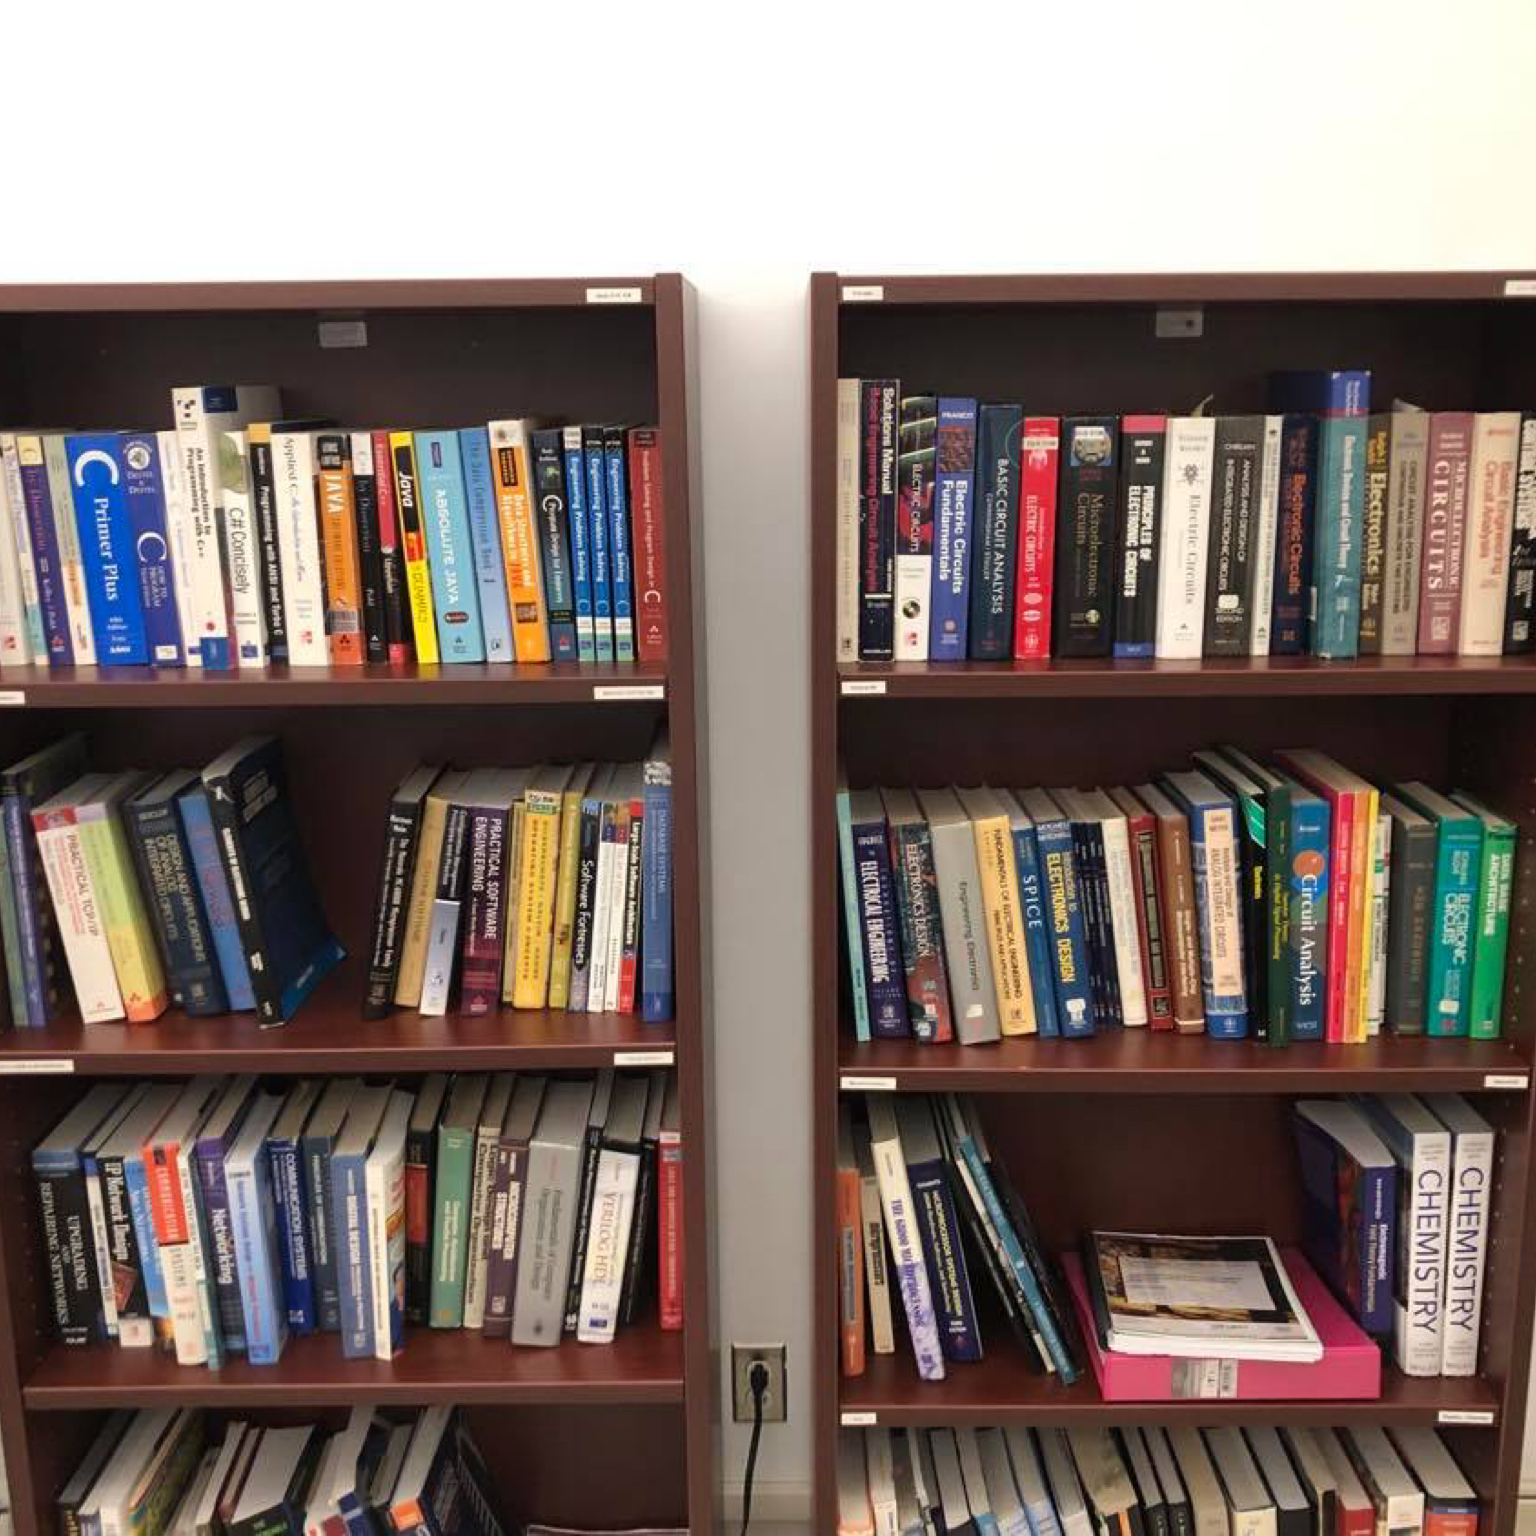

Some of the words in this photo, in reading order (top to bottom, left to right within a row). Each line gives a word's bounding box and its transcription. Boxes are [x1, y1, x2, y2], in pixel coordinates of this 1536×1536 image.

[881, 388, 895, 446] Solutions
[74, 450, 119, 487] C
[187, 447, 200, 514] Programming
[199, 463, 211, 523] Introduction
[325, 474, 345, 514] JAVA
[399, 471, 414, 508] Java
[610, 458, 621, 511] Engineering
[881, 449, 893, 495] Manual
[911, 463, 923, 507] ELECTRIC
[996, 458, 1010, 497] BASIC
[94, 498, 113, 560] Primer
[229, 508, 245, 530] C#
[614, 512, 624, 550] Problem
[909, 511, 921, 552] CIRCUITS
[939, 480, 955, 582] Fundamentals
[954, 480, 969, 534] Electric
[993, 500, 1008, 549] CIRCUIT
[1076, 493, 1090, 545] Circuits
[1126, 485, 1141, 547] ELECTRONIC
[1140, 485, 1156, 545] PRINCIPLES
[1187, 494, 1202, 549] Electric
[1367, 473, 1388, 576] Electronics
[1427, 460, 1451, 589] CIRCUITS
[1449, 461, 1467, 587] MICROELECTRONIC
[137, 531, 167, 562] C
[231, 532, 251, 594] Concisely
[434, 490, 455, 565] ABSOLUTE
[446, 569, 459, 604] JAVA
[615, 551, 625, 582] Solving
[951, 538, 968, 594] Circuits
[1087, 494, 1106, 597] Microelectronic
[1140, 548, 1153, 562] OF
[103, 564, 119, 601] Plus
[991, 552, 1006, 614] ANALYSIS
[1124, 551, 1138, 598] CIRCUITS
[1185, 553, 1198, 605] Circuits
[67, 834, 88, 895] PRACTICAL
[471, 816, 488, 892] ENGINEERING
[487, 818, 502, 877] PRACTICAL
[578, 859, 595, 908] Software
[861, 861, 884, 917] ELECTRICAL
[905, 844, 927, 917] ELECTRONICS
[1022, 874, 1043, 930] SPICE
[1046, 853, 1070, 934] ELECTRONICS
[1300, 873, 1318, 932] Circuit
[484, 880, 500, 940] SOFTWARE
[574, 910, 590, 967] Fortresses
[914, 919, 931, 958] DESIGN
[957, 881, 975, 941] Engineering
[1441, 893, 1458, 945] CIRCUITS
[1451, 893, 1472, 965] ELECTRONIC
[867, 919, 891, 984] ENGINEERING
[1056, 938, 1076, 983] DESIGN
[1293, 936, 1318, 1006] Analysis
[104, 1162, 122, 1175] IP
[286, 1153, 304, 1234] COMMUNICATION
[41, 1182, 60, 1251] REPAIRING
[106, 1177, 126, 1221] Network
[67, 1215, 89, 1291] UPGRADING
[111, 1223, 131, 1261] Design
[211, 1208, 235, 1284] Networking
[292, 1236, 308, 1281] SYSTEMS
[1413, 1169, 1443, 1333] CHEMISTRY
[1450, 1167, 1485, 1331] CHEMISTRY
[50, 1253, 70, 1325] NETWORKS
